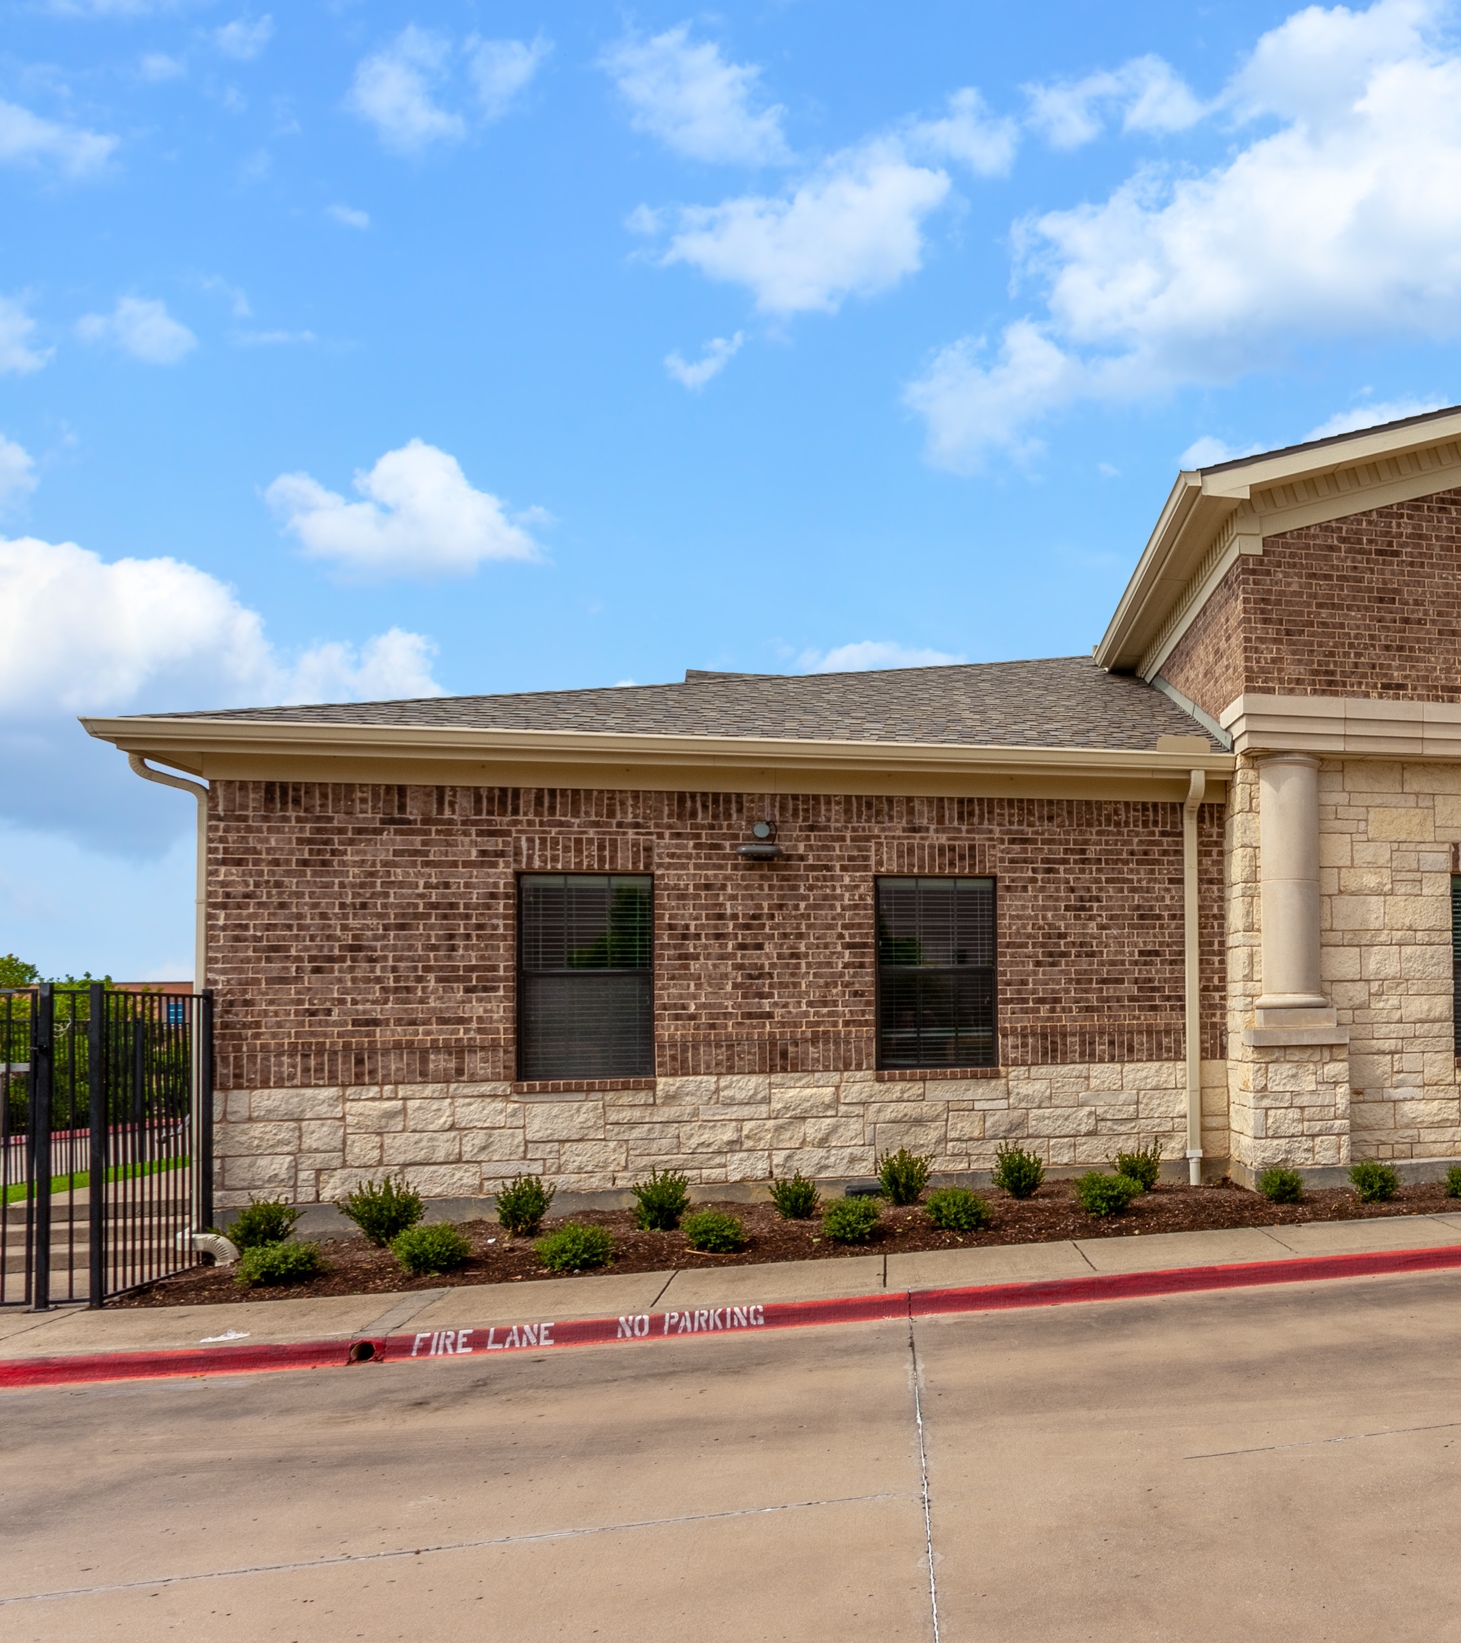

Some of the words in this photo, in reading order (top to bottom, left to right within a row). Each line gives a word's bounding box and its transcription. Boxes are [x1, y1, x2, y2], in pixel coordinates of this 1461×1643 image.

[411, 1328, 474, 1357] FIRE
[486, 1322, 555, 1350] LANE
[616, 1314, 650, 1339] NO
[664, 1304, 765, 1336] PARKING
